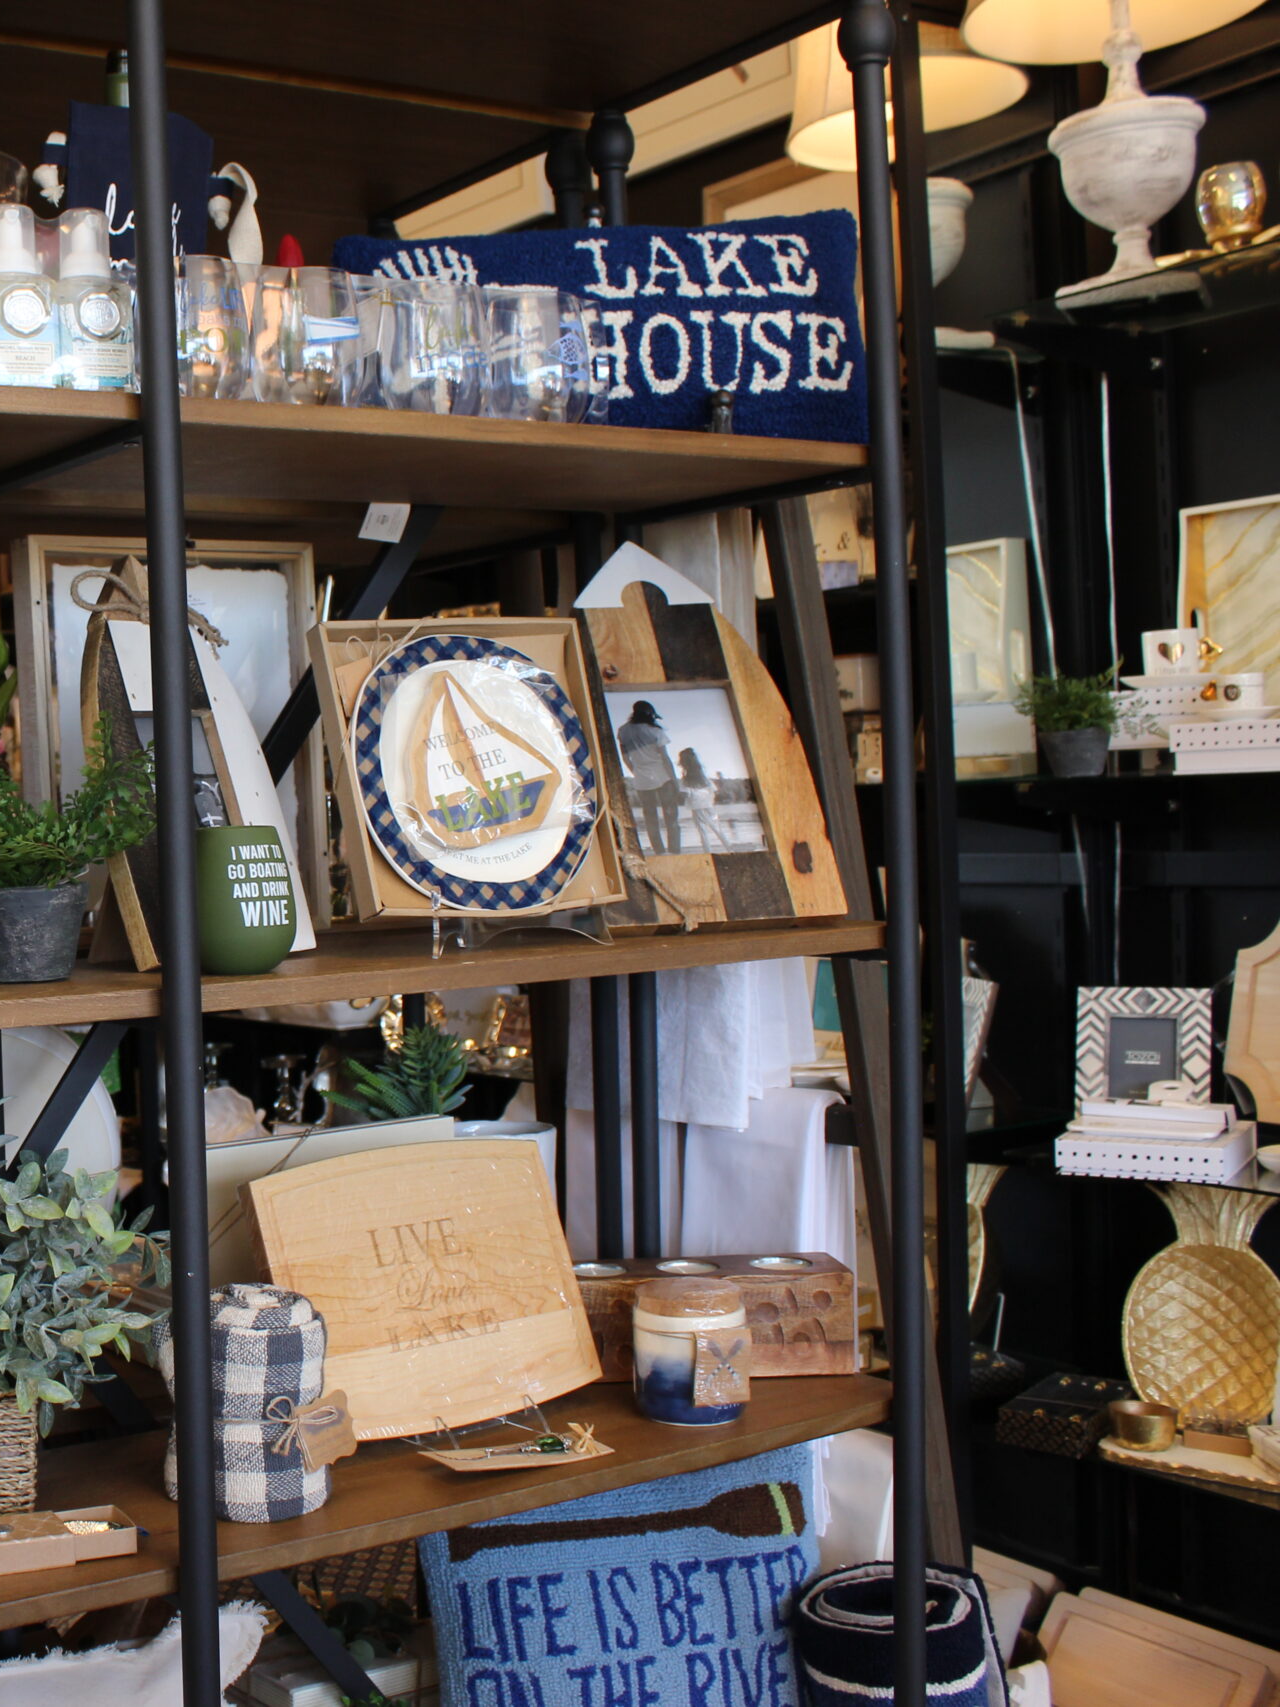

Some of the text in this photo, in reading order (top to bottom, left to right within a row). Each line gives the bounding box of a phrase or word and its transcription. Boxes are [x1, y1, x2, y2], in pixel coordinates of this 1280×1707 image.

[574, 231, 819, 299] LAKE
[564, 309, 853, 400] HOUSE
[423, 720, 498, 752] WELCOME
[437, 748, 507, 782] TO THE
[434, 771, 532, 832] LAKE
[231, 844, 282, 861] I WANT TO
[465, 854, 480, 865] ME
[480, 856, 493, 865] AT
[492, 852, 512, 865] THE
[510, 841, 533, 859] LAKE
[227, 862, 288, 880] GO BOATING
[233, 880, 290, 899] AND DRINK
[240, 899, 290, 928] WINE
[384, 1308, 502, 1353] LAKE
[457, 1573, 578, 1662] LIFE
[586, 1559, 639, 1653] IS
[567, 1655, 661, 1707] THE
